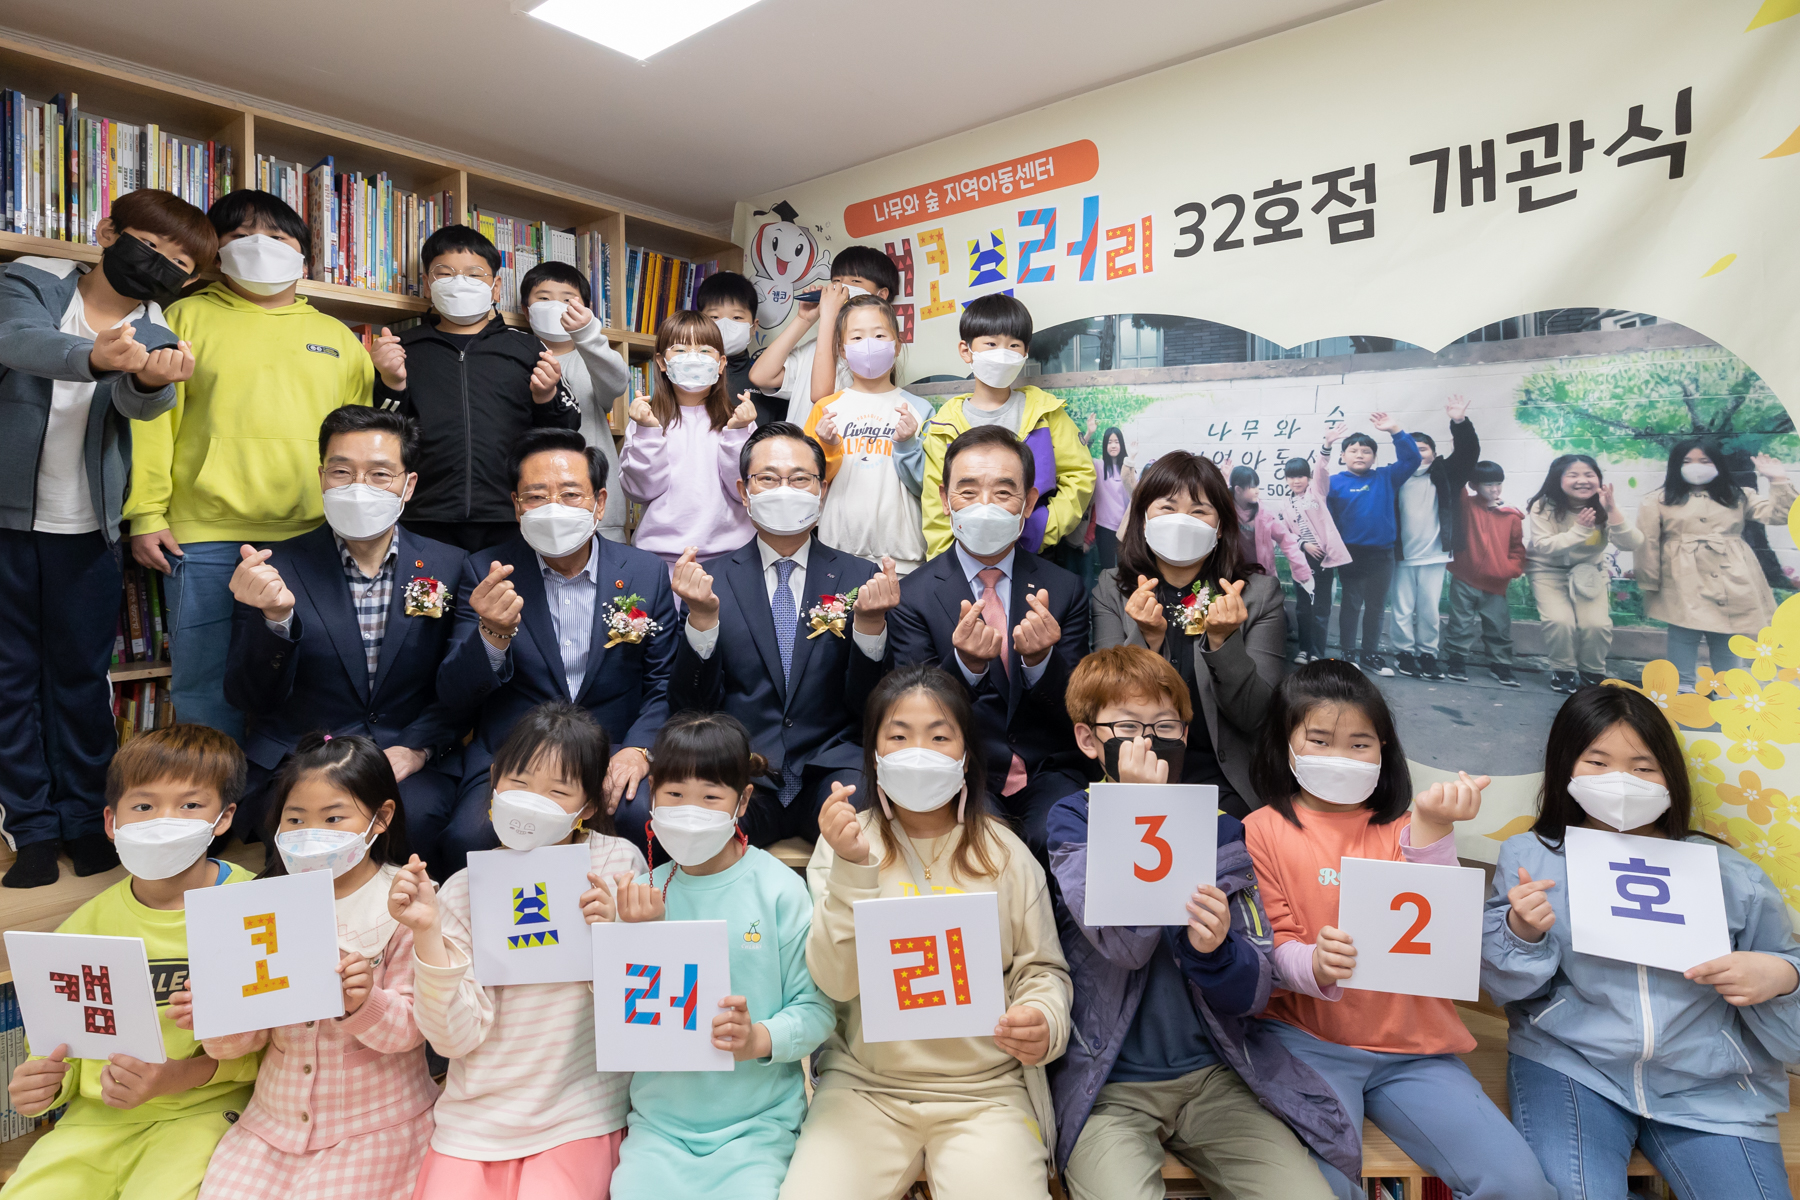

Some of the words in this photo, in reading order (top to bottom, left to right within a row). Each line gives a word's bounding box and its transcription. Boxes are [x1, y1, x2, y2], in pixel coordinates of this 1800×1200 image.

[873, 194, 919, 222] 나무와
[925, 188, 939, 213] 숲
[943, 157, 1055, 204] 지역아동센터
[1173, 163, 1377, 257] 32호점
[1409, 86, 1692, 213] 개관식
[772, 290, 787, 302] 캠코
[842, 421, 881, 444] Living
[882, 422, 896, 435] in
[1133, 815, 1173, 883] 3
[507, 882, 559, 950] 브
[1388, 891, 1432, 955] 2
[1608, 857, 1686, 925] 호
[242, 912, 290, 998] 코
[889, 927, 971, 1011] 리
[49, 964, 117, 1036] 캠
[624, 963, 698, 1031] 러
